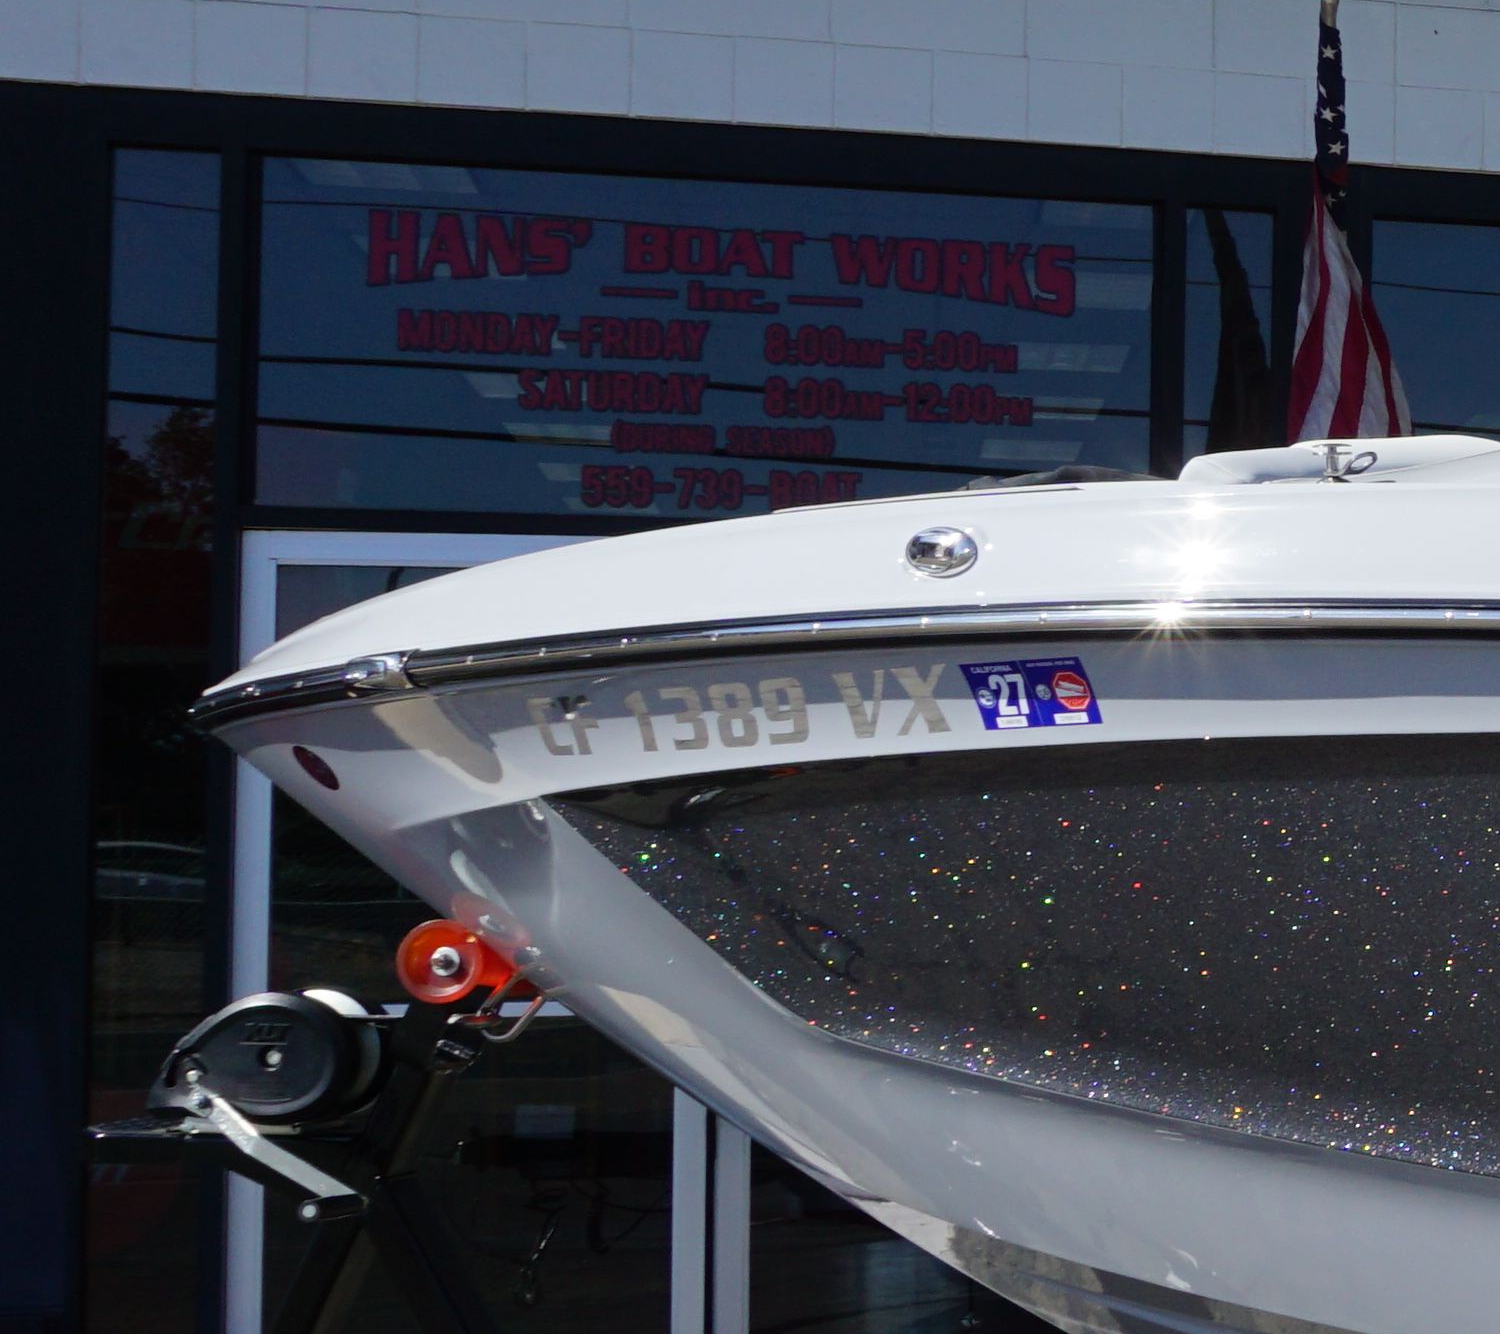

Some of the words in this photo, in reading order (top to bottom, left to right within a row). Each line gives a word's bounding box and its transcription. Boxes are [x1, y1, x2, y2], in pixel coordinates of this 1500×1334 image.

[366, 208, 592, 287] HANS'
[624, 224, 804, 280] BOAT
[831, 233, 1076, 316] WORKS
[396, 308, 711, 361] MONDAY-FRIDAY
[517, 370, 710, 414] SATURDAY
[624, 678, 810, 753] 1389
[831, 663, 952, 739] VX
[988, 673, 1030, 716] 27
